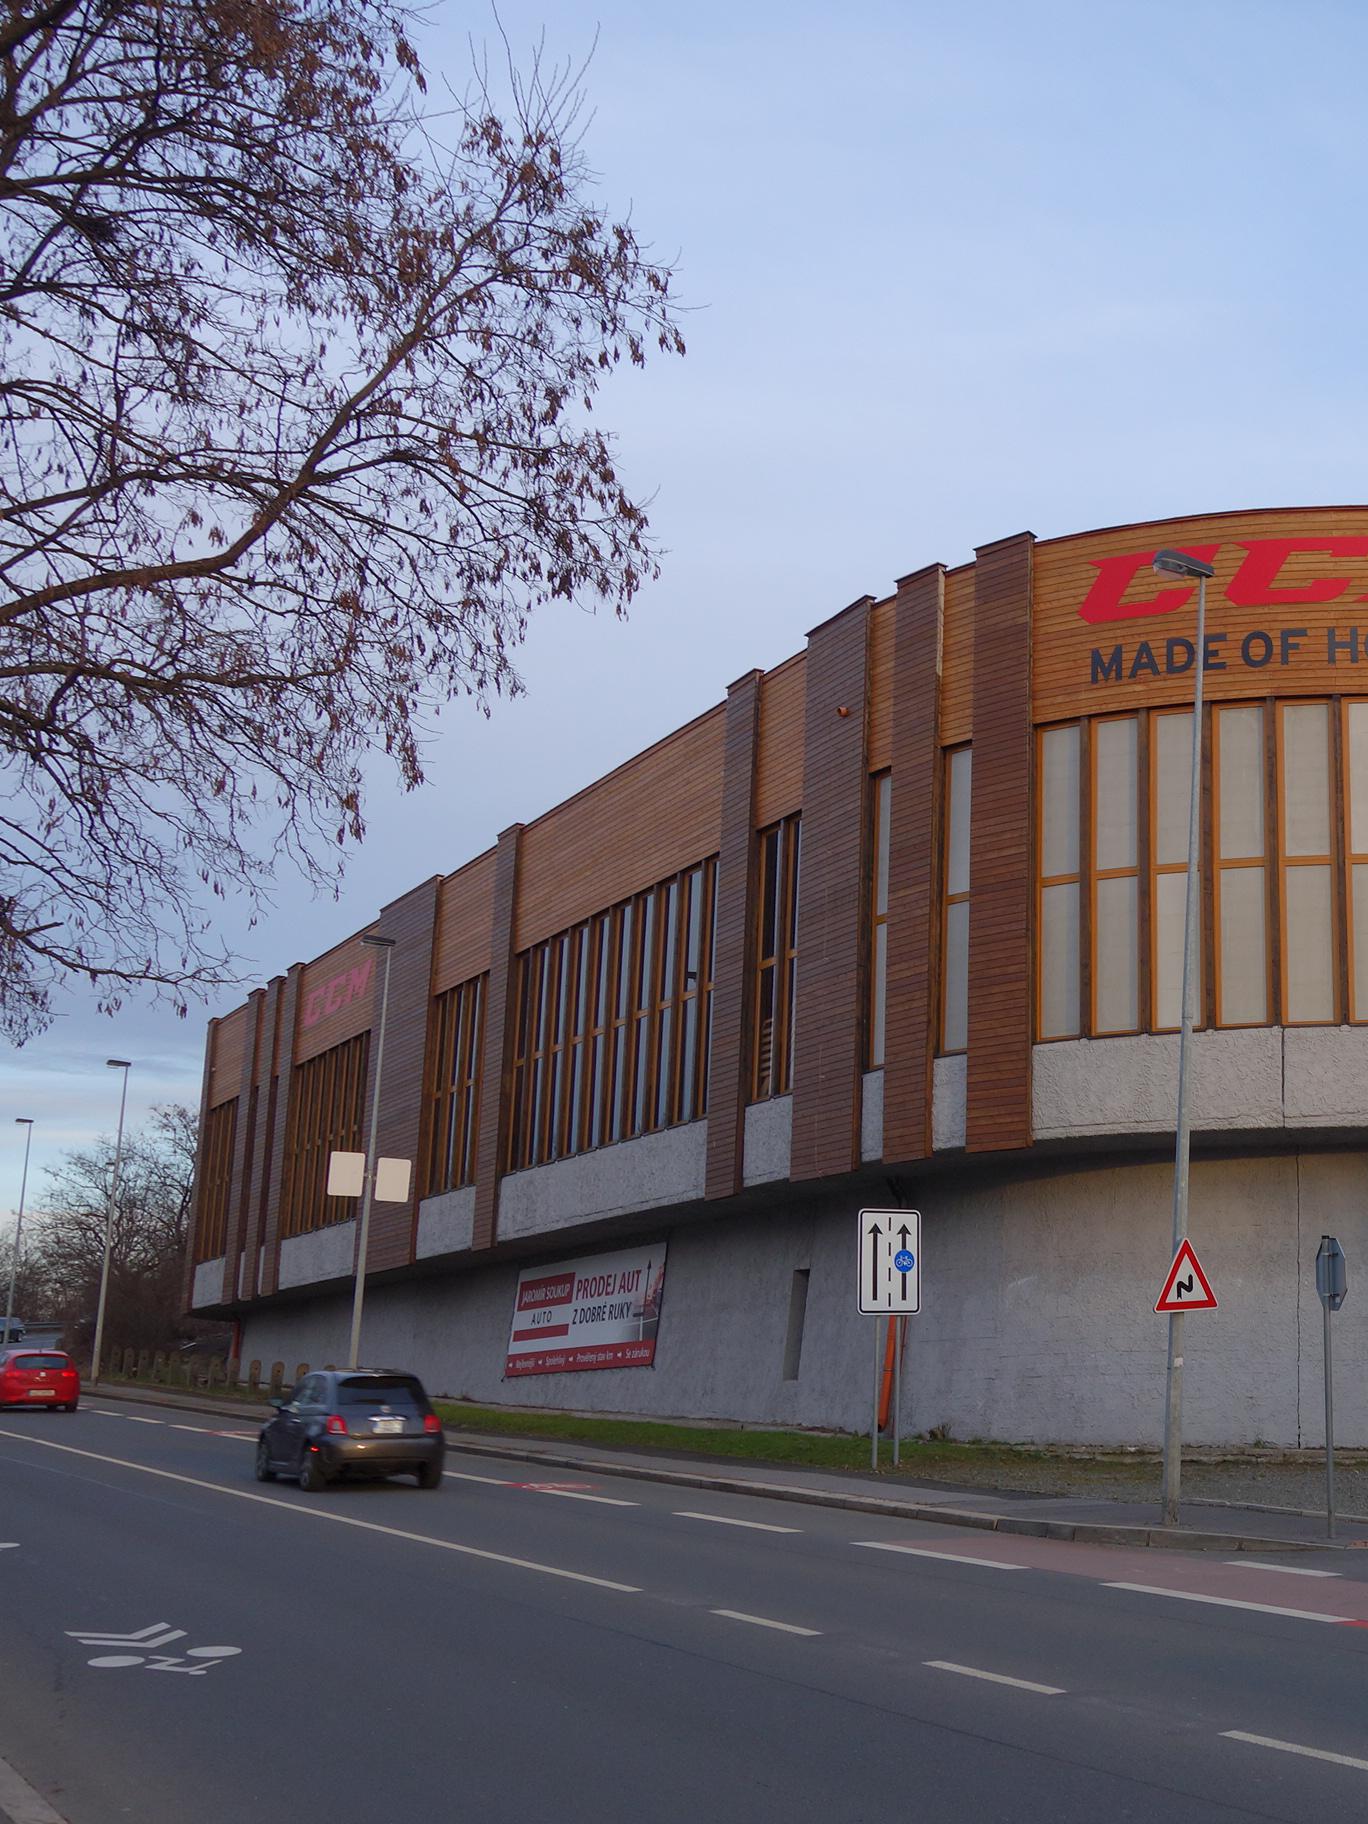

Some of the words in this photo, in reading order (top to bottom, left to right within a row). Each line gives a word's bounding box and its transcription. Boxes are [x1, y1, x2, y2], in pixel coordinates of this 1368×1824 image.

[1090, 633, 1228, 684] MADE
[1241, 628, 1308, 668] OF
[304, 959, 372, 1027] CCM
[546, 1283, 571, 1300] SOUKUP
[576, 1274, 616, 1300] PRODEJ
[618, 1270, 641, 1293] AUT
[531, 1311, 552, 1325] AUTO
[572, 1309, 578, 1324] Z
[579, 1303, 607, 1324] DOBRÉ
[608, 1302, 632, 1320] RUKY
